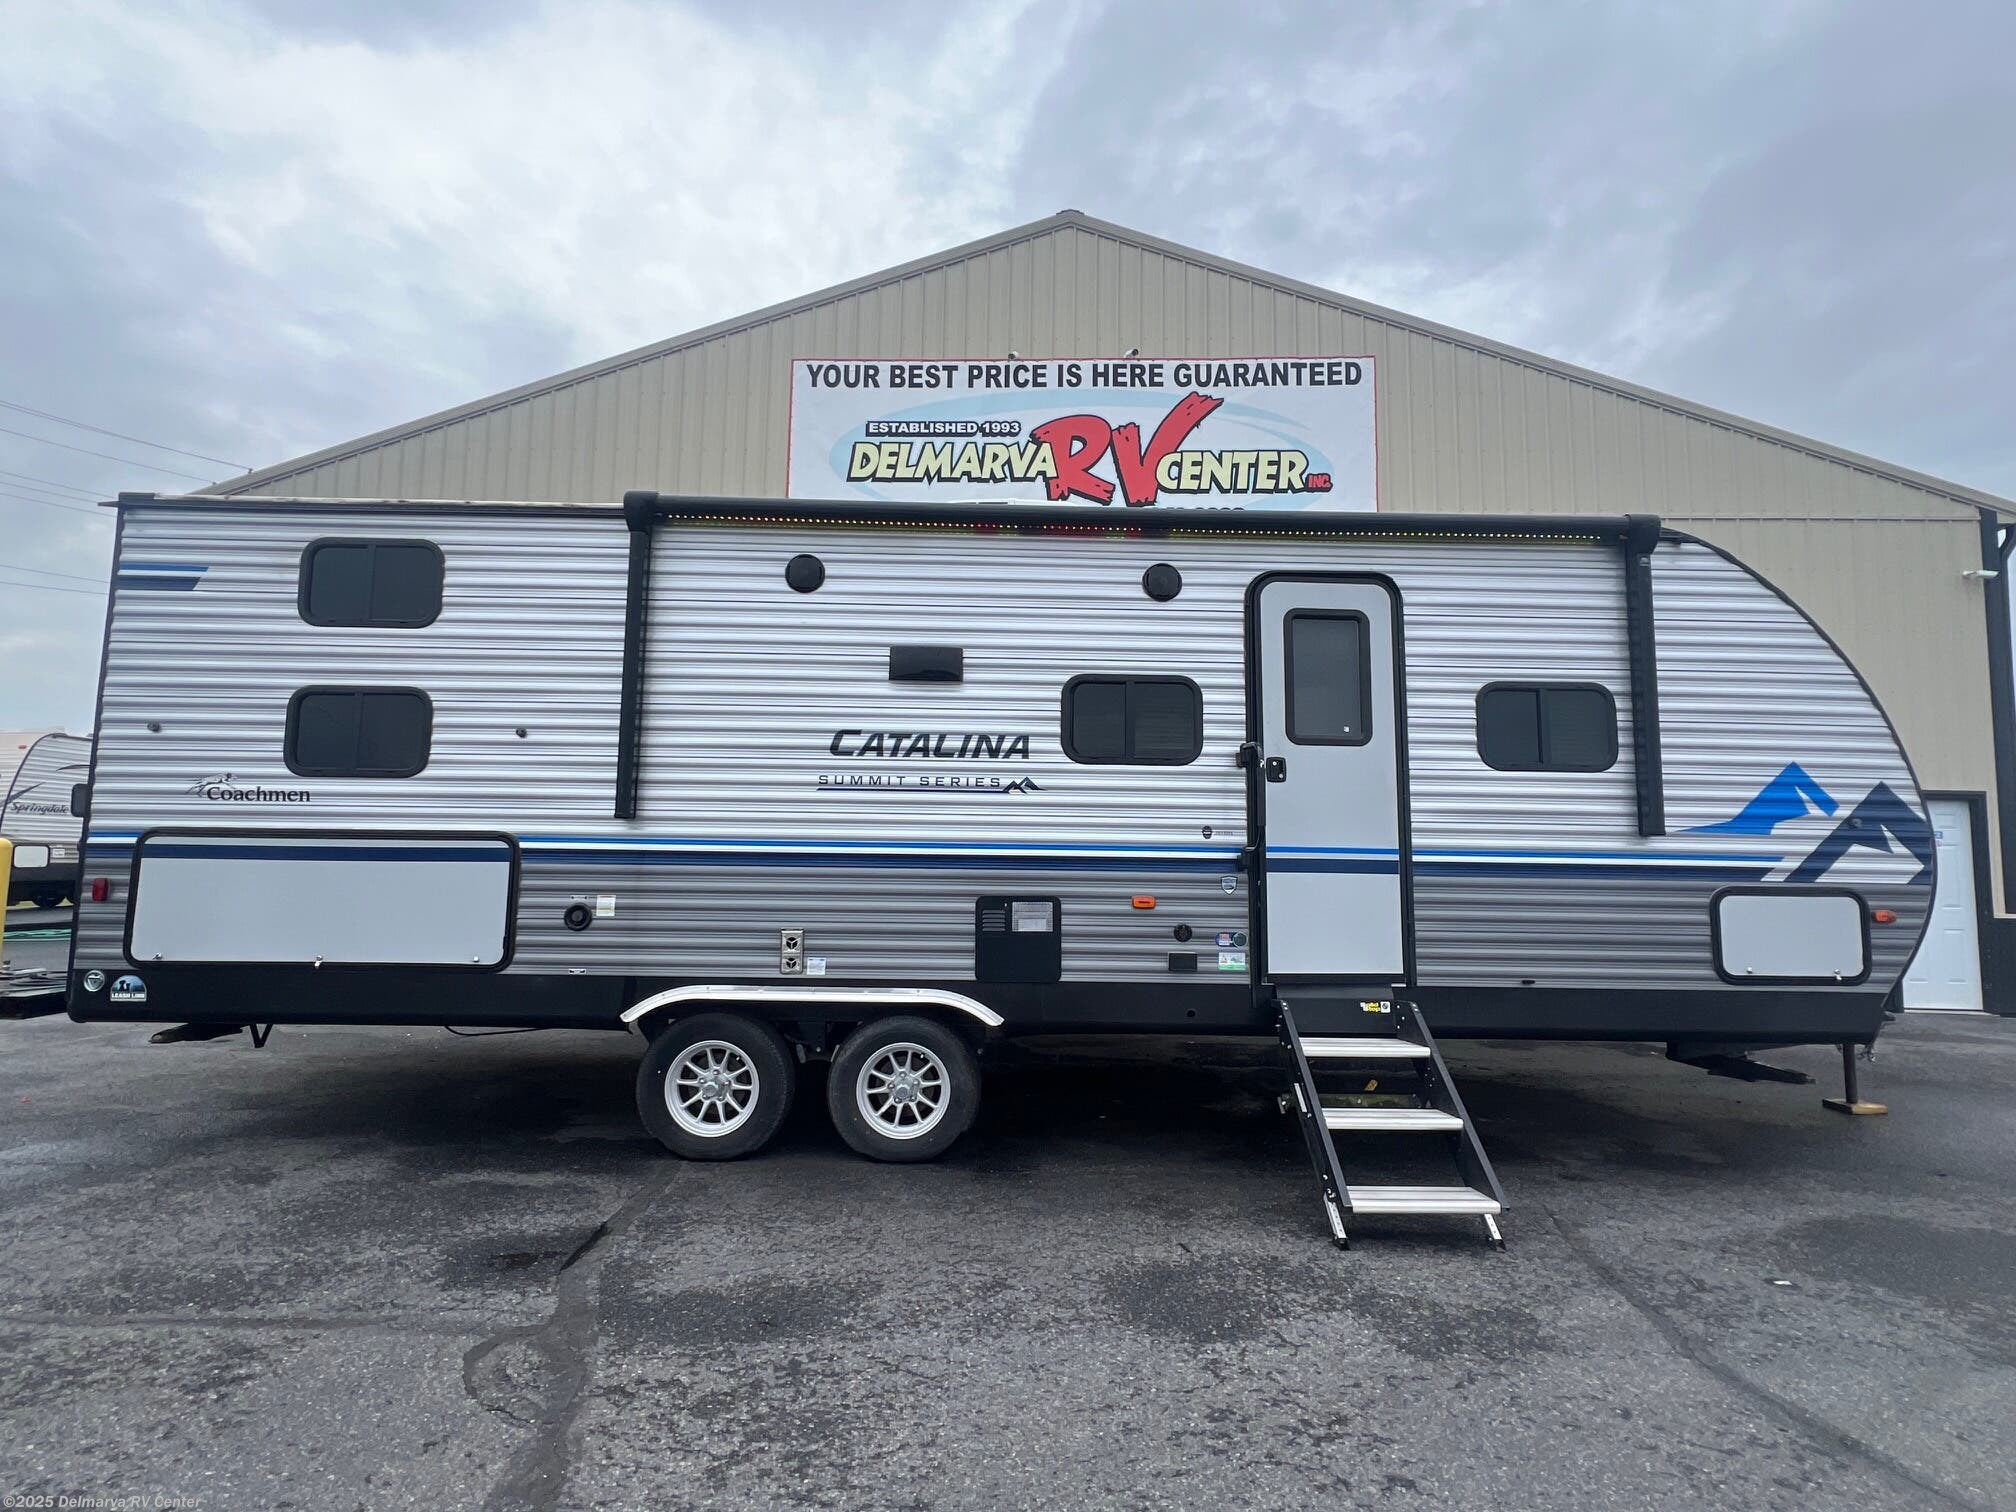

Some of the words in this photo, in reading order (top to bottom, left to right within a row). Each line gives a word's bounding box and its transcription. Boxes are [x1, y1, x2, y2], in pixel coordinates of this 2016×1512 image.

[807, 364, 880, 388] YOUR
[889, 364, 958, 388] BEST
[968, 364, 1047, 388] PRICE
[1057, 363, 1082, 388] IS
[1092, 363, 1164, 388] HERE
[1173, 361, 1362, 388] GUARANTEED
[867, 421, 979, 436] ESTABLISHED
[982, 420, 1021, 435] 1993
[848, 441, 1058, 486] DELMARVA
[1029, 391, 1224, 506] RV
[1156, 450, 1308, 493] CENTER
[829, 728, 1030, 760] CATALINA
[818, 774, 906, 787] SUMMIT
[919, 776, 1001, 788] SERIES
[206, 785, 311, 803] Coachmen
